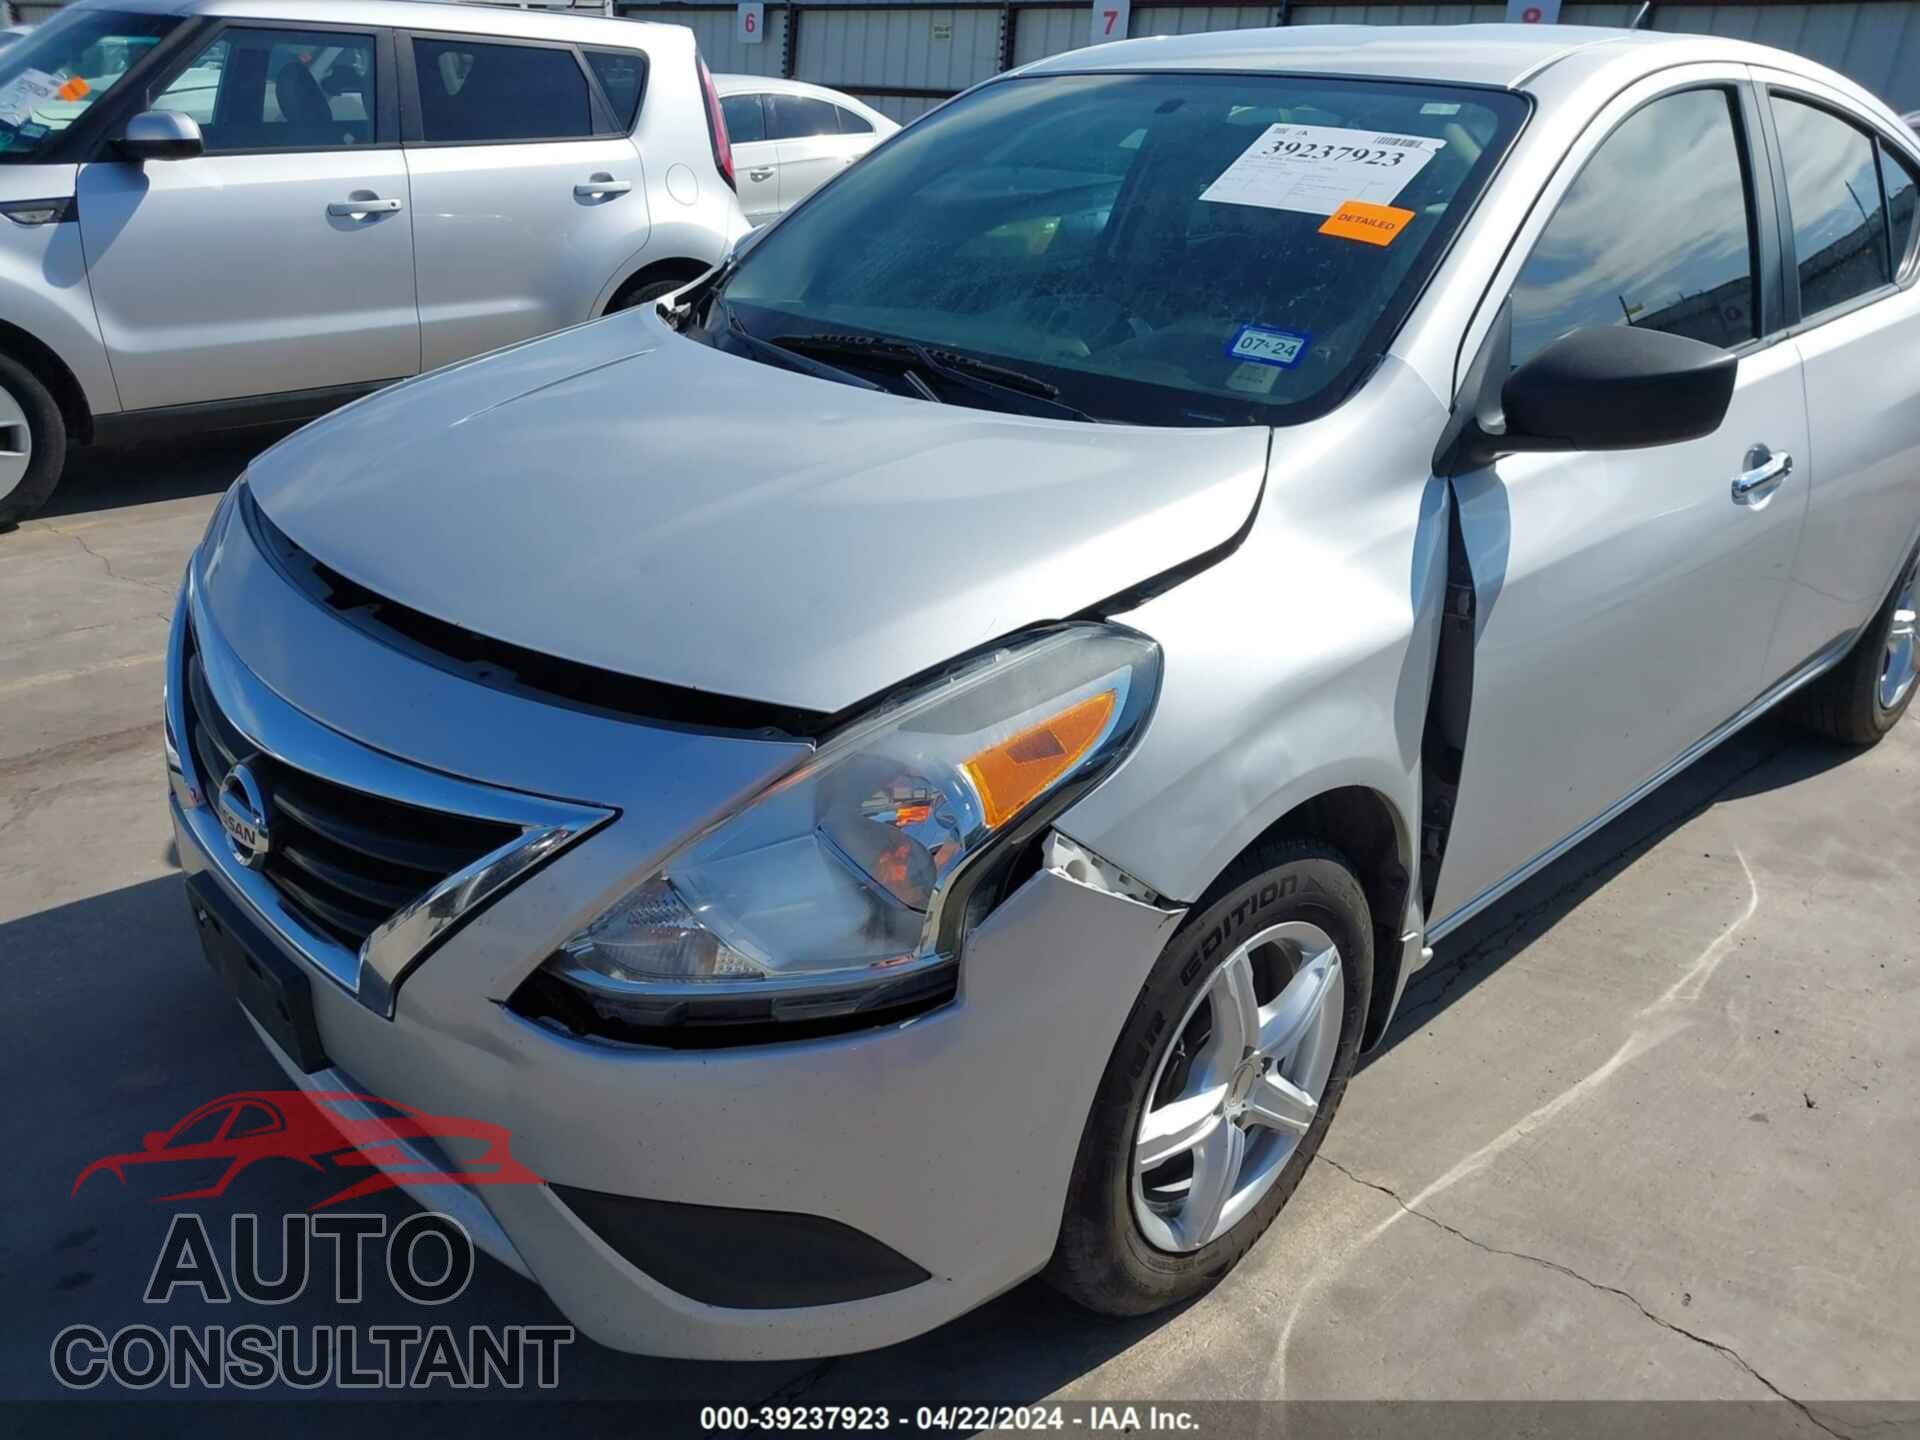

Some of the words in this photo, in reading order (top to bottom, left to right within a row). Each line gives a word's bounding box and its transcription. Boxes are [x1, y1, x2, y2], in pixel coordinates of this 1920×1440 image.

[744, 13, 755, 32] 6
[1103, 11, 1119, 35] 7
[1262, 140, 1405, 167] 39237923
[1337, 213, 1396, 230] DETAILED
[1180, 874, 1298, 987] EDITION
